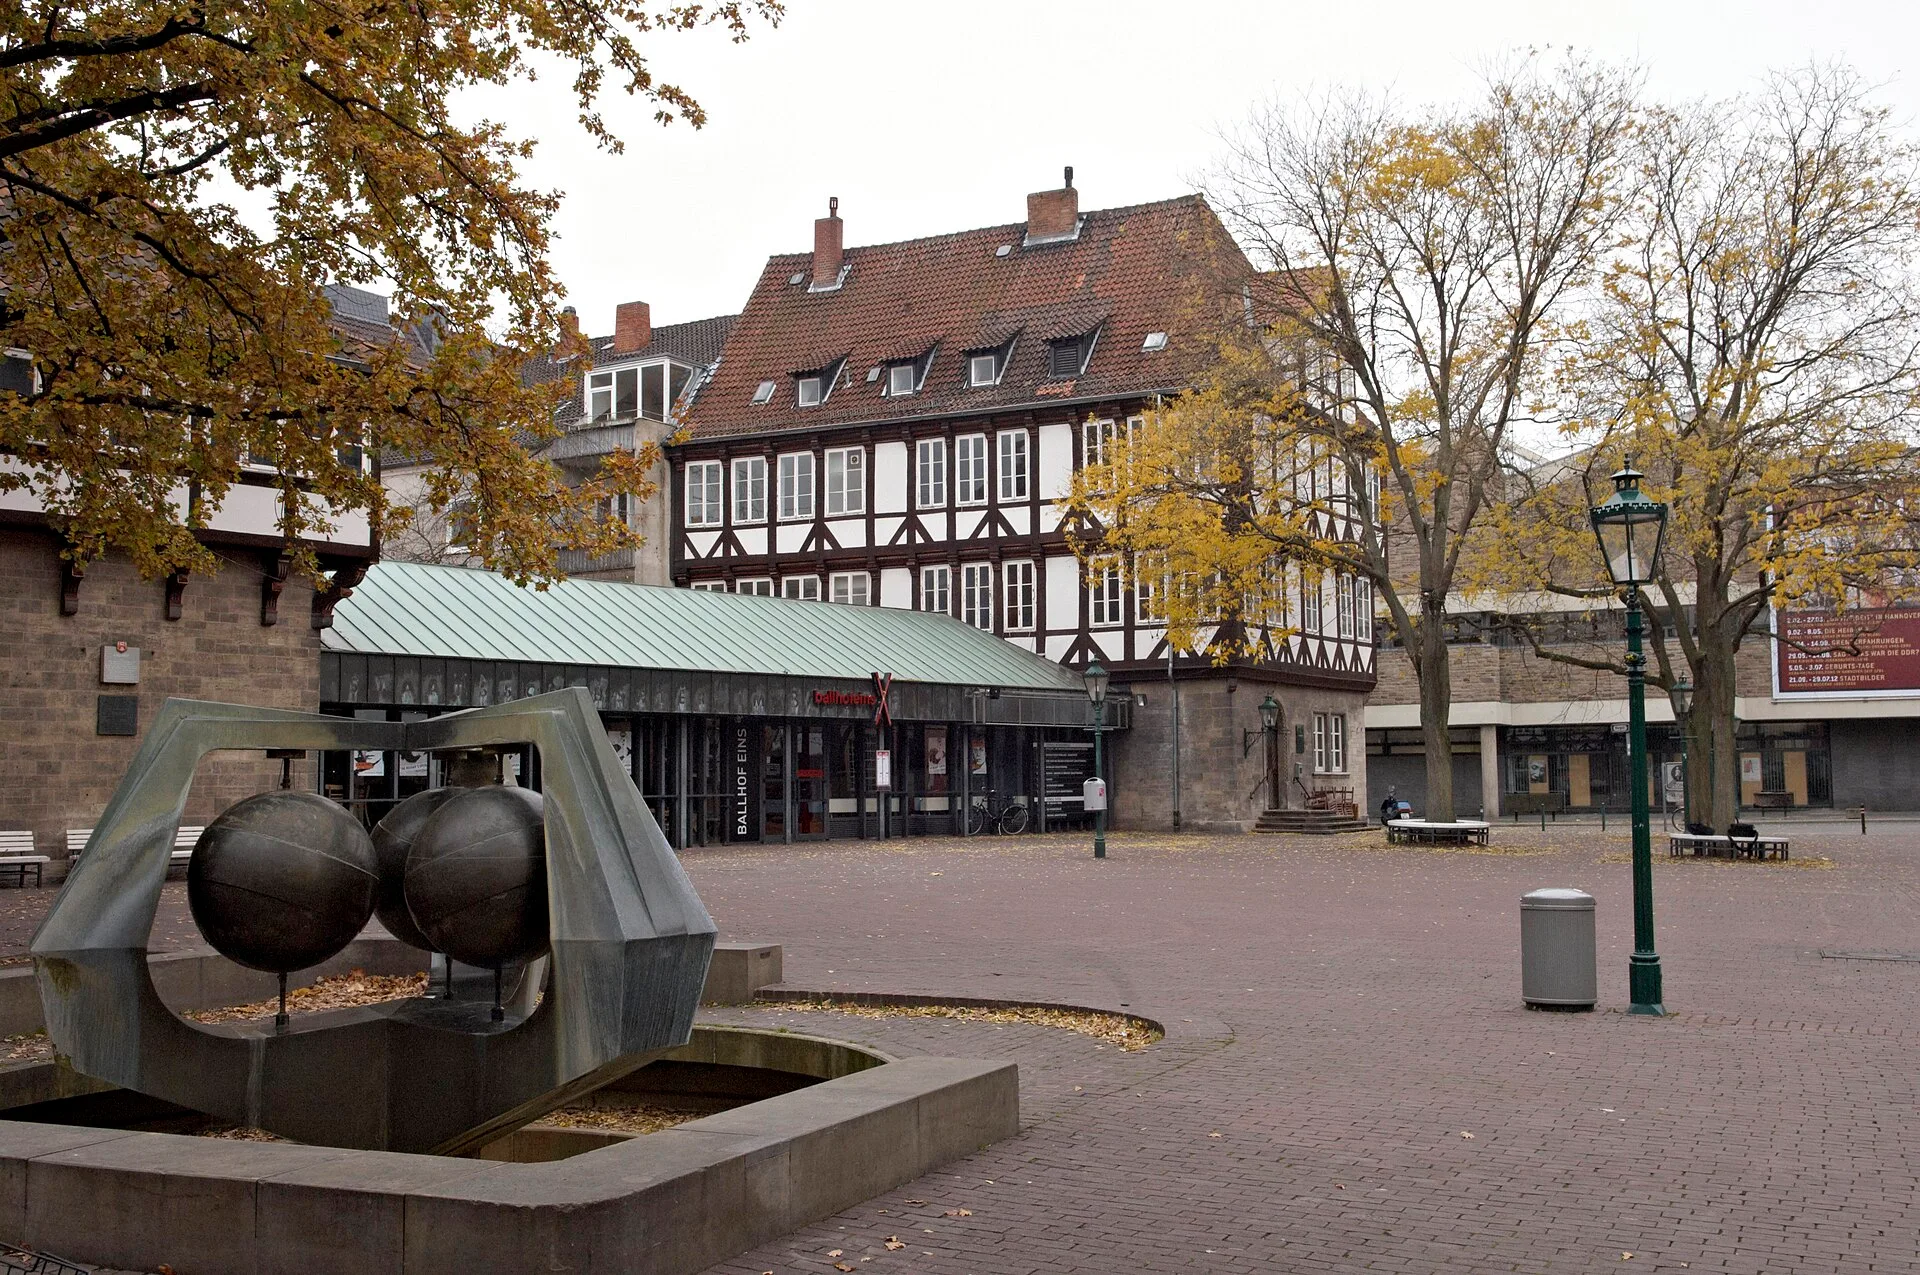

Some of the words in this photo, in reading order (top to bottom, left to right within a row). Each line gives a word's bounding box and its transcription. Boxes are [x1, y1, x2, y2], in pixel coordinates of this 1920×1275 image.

[1900, 648, 1920, 656] DDR?
[1839, 674, 1886, 682] STADTBILDER
[737, 728, 747, 762] EINS
[737, 767, 747, 835] BALLHOF
